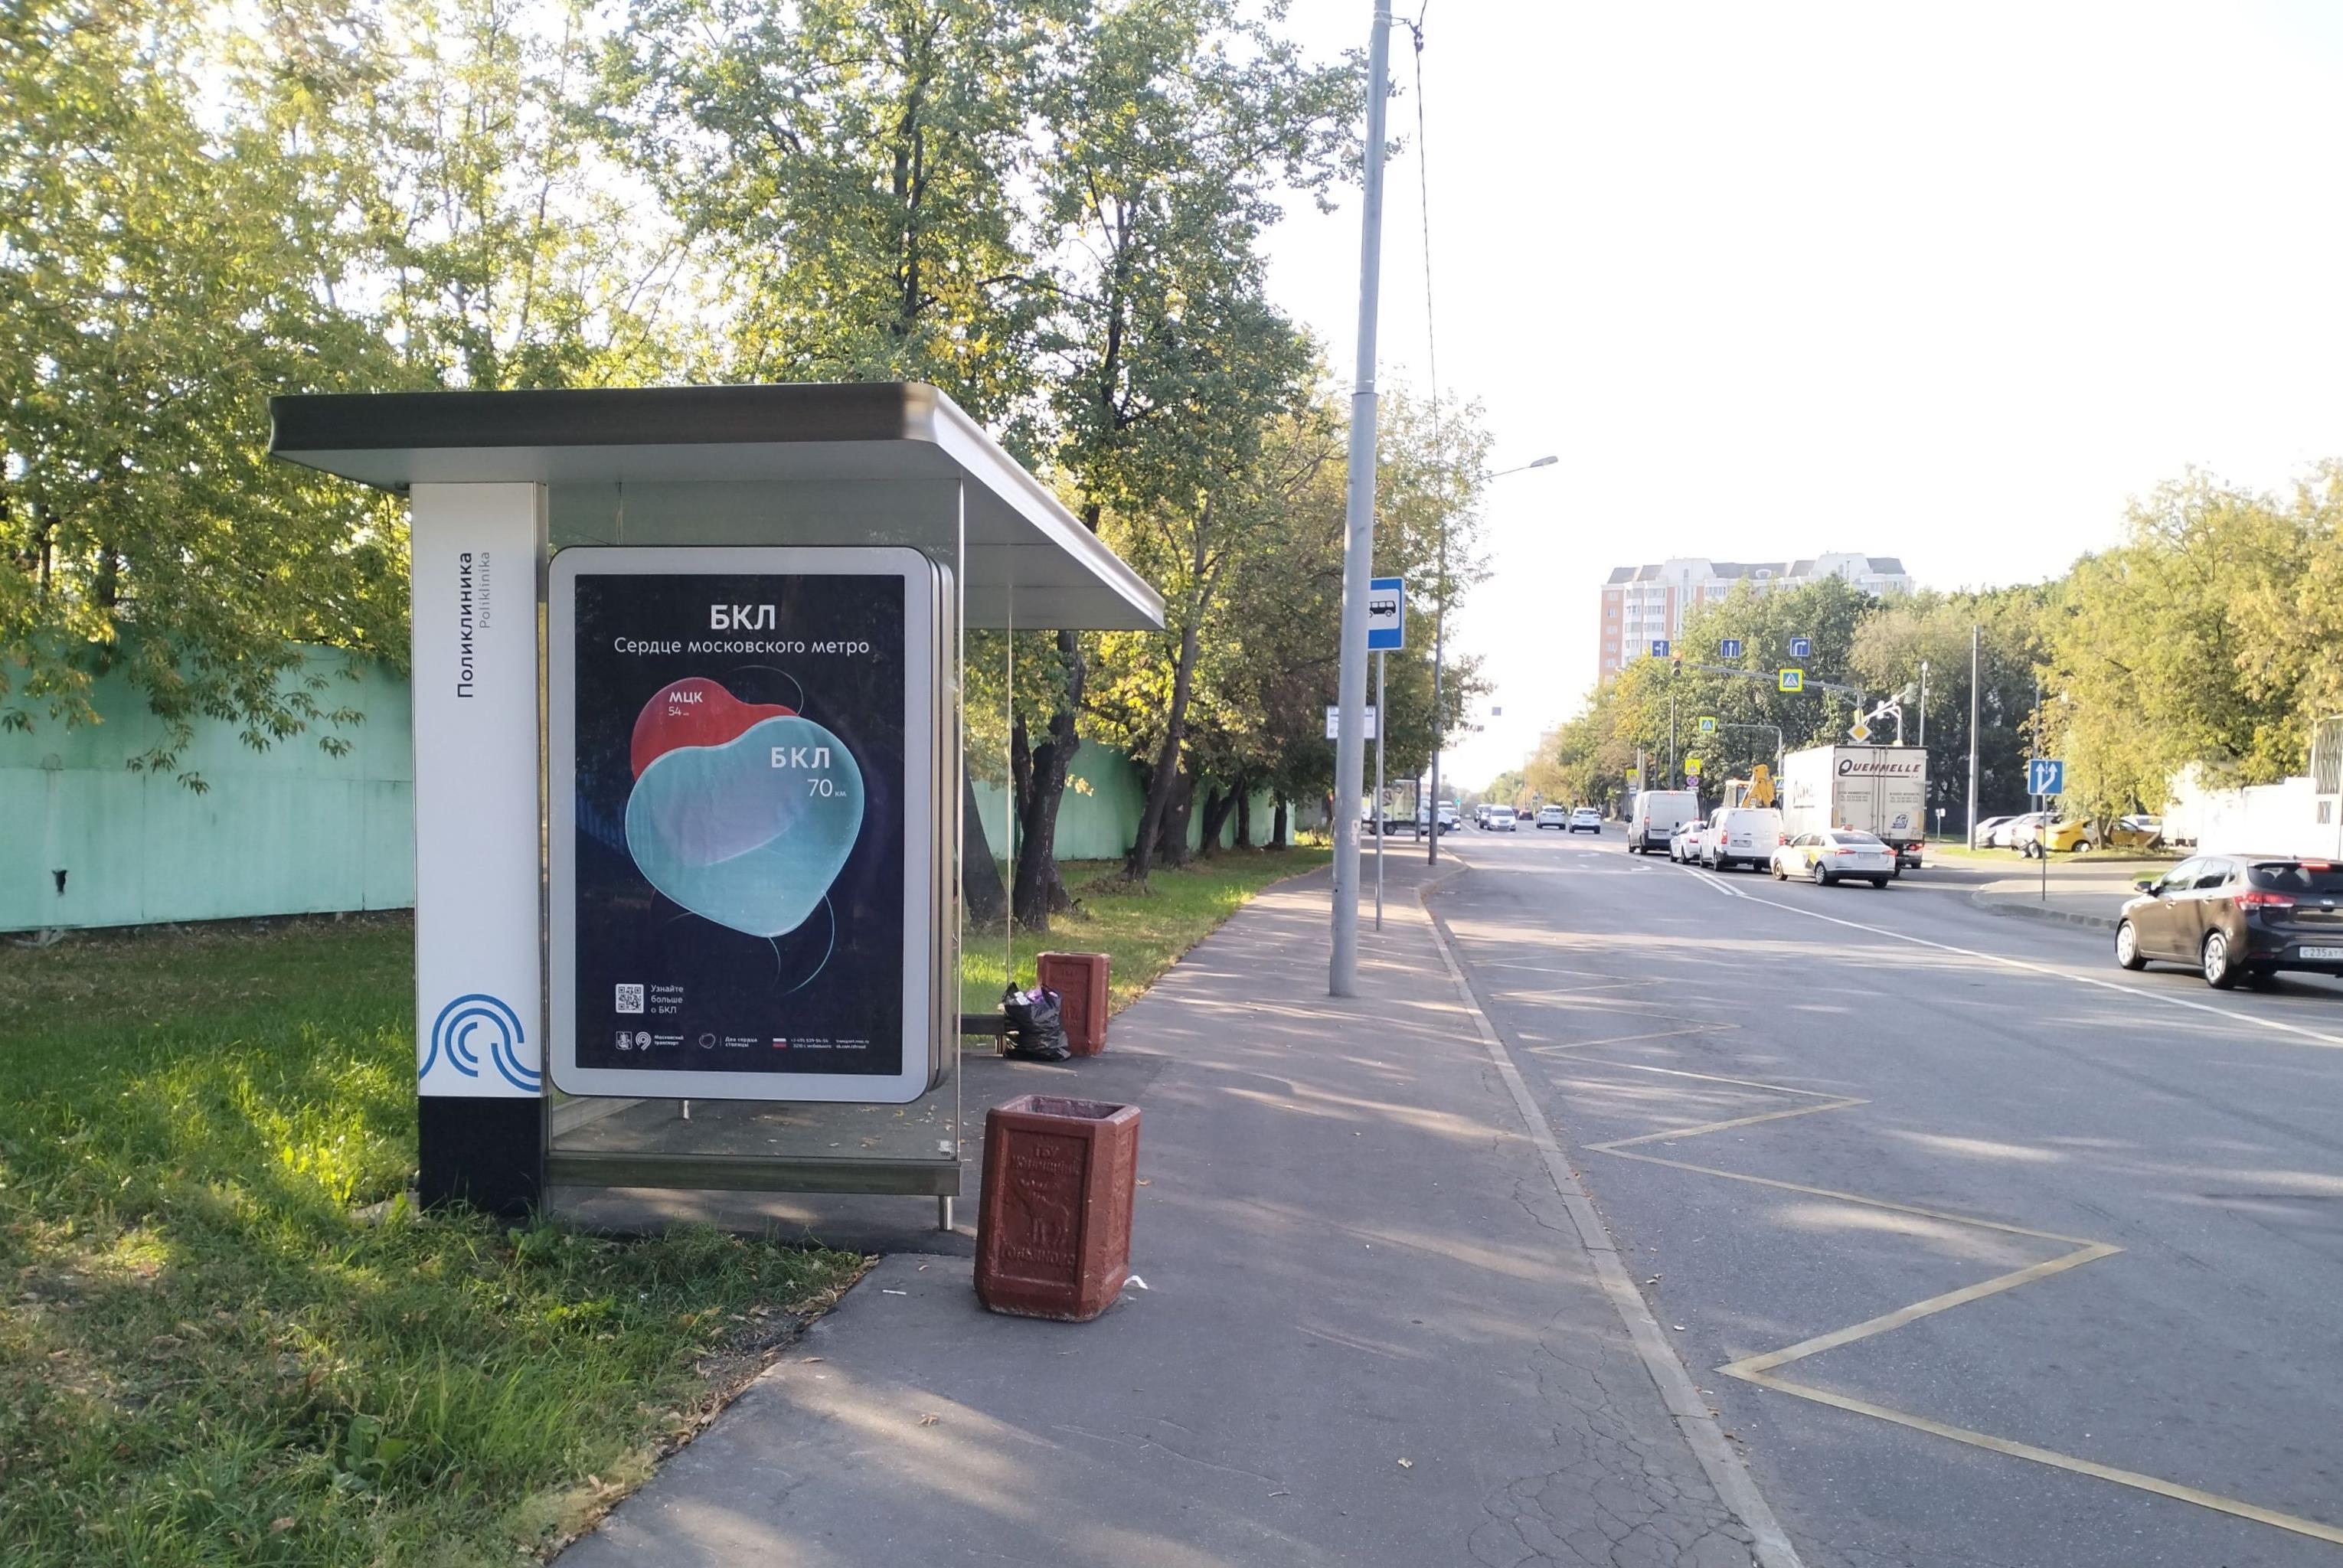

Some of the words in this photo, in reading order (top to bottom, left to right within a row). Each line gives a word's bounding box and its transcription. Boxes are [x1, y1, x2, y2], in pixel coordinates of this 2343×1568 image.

[479, 552, 490, 629] Poliklinika
[457, 552, 473, 697] Поликлиника
[711, 605, 775, 629] БКЛ
[614, 637, 681, 655] Сердце
[688, 642, 805, 654] московского
[812, 642, 869, 656] метро
[668, 691, 703, 704] МЦК
[668, 706, 681, 716] 54
[771, 746, 829, 769] БКЛ
[807, 779, 832, 797] 70
[650, 984, 684, 993] Узнайте
[650, 995, 683, 1004] больше
[658, 1005, 677, 1014] БКЛ
